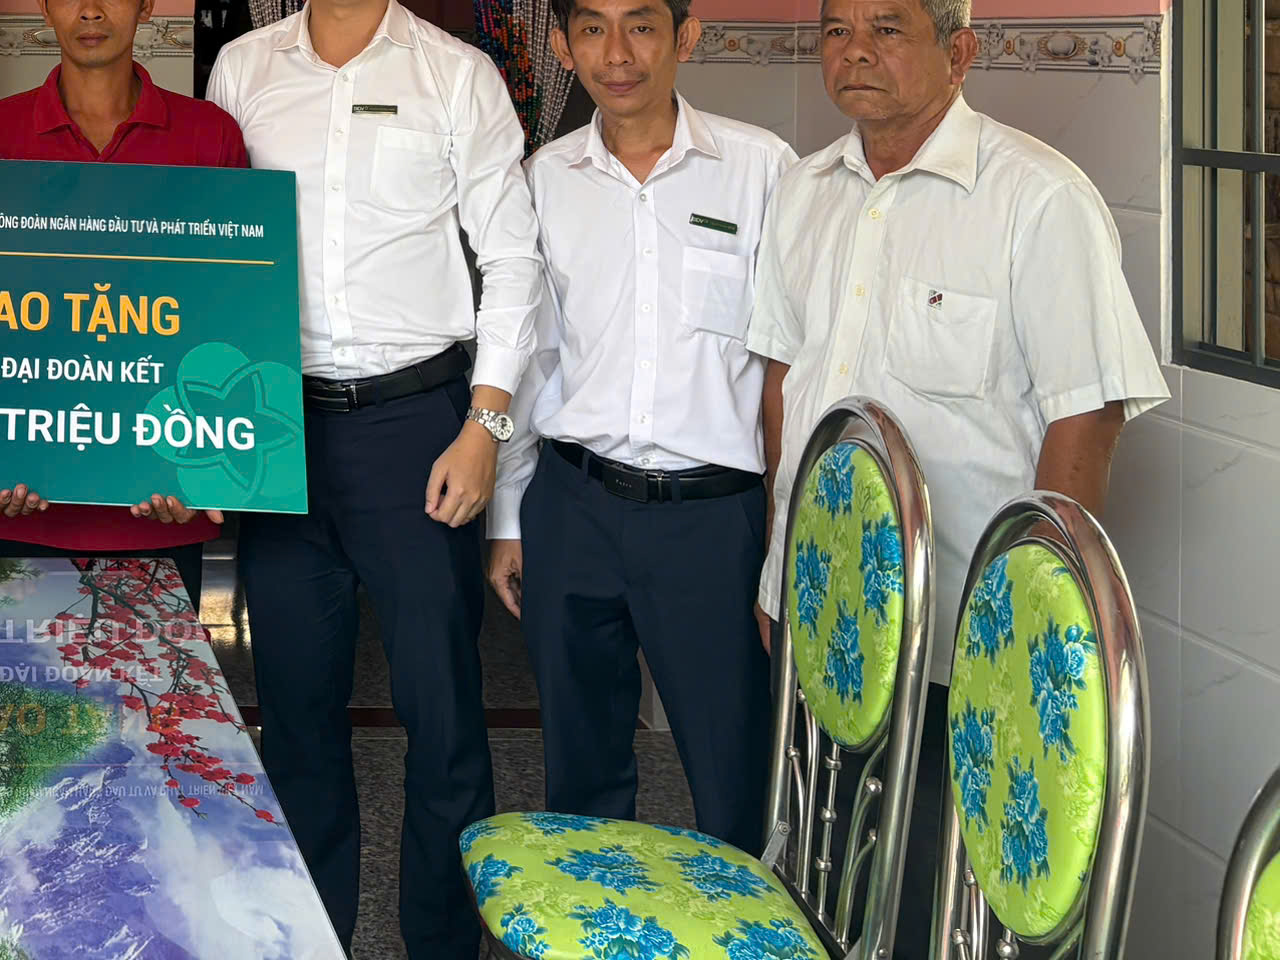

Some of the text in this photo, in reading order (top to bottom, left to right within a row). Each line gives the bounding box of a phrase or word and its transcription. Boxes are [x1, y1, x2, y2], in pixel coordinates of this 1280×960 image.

[20, 213, 48, 230] ĐOÀN
[49, 215, 77, 231] NGÂN
[79, 215, 107, 232] HÀNG
[108, 215, 129, 233] ĐẦU
[131, 218, 146, 233] TƯ
[145, 217, 159, 234] VÀ
[160, 218, 185, 235] PHÁT
[188, 218, 217, 237] TRIỂN
[218, 221, 240, 239] VIỆT
[241, 224, 265, 238] NAM
[63, 282, 181, 342] TẶNG
[1, 356, 40, 384] ĐẠI
[47, 355, 113, 382] ĐOÀN
[120, 354, 164, 384] KẾT
[132, 403, 256, 451] ĐỒNG
